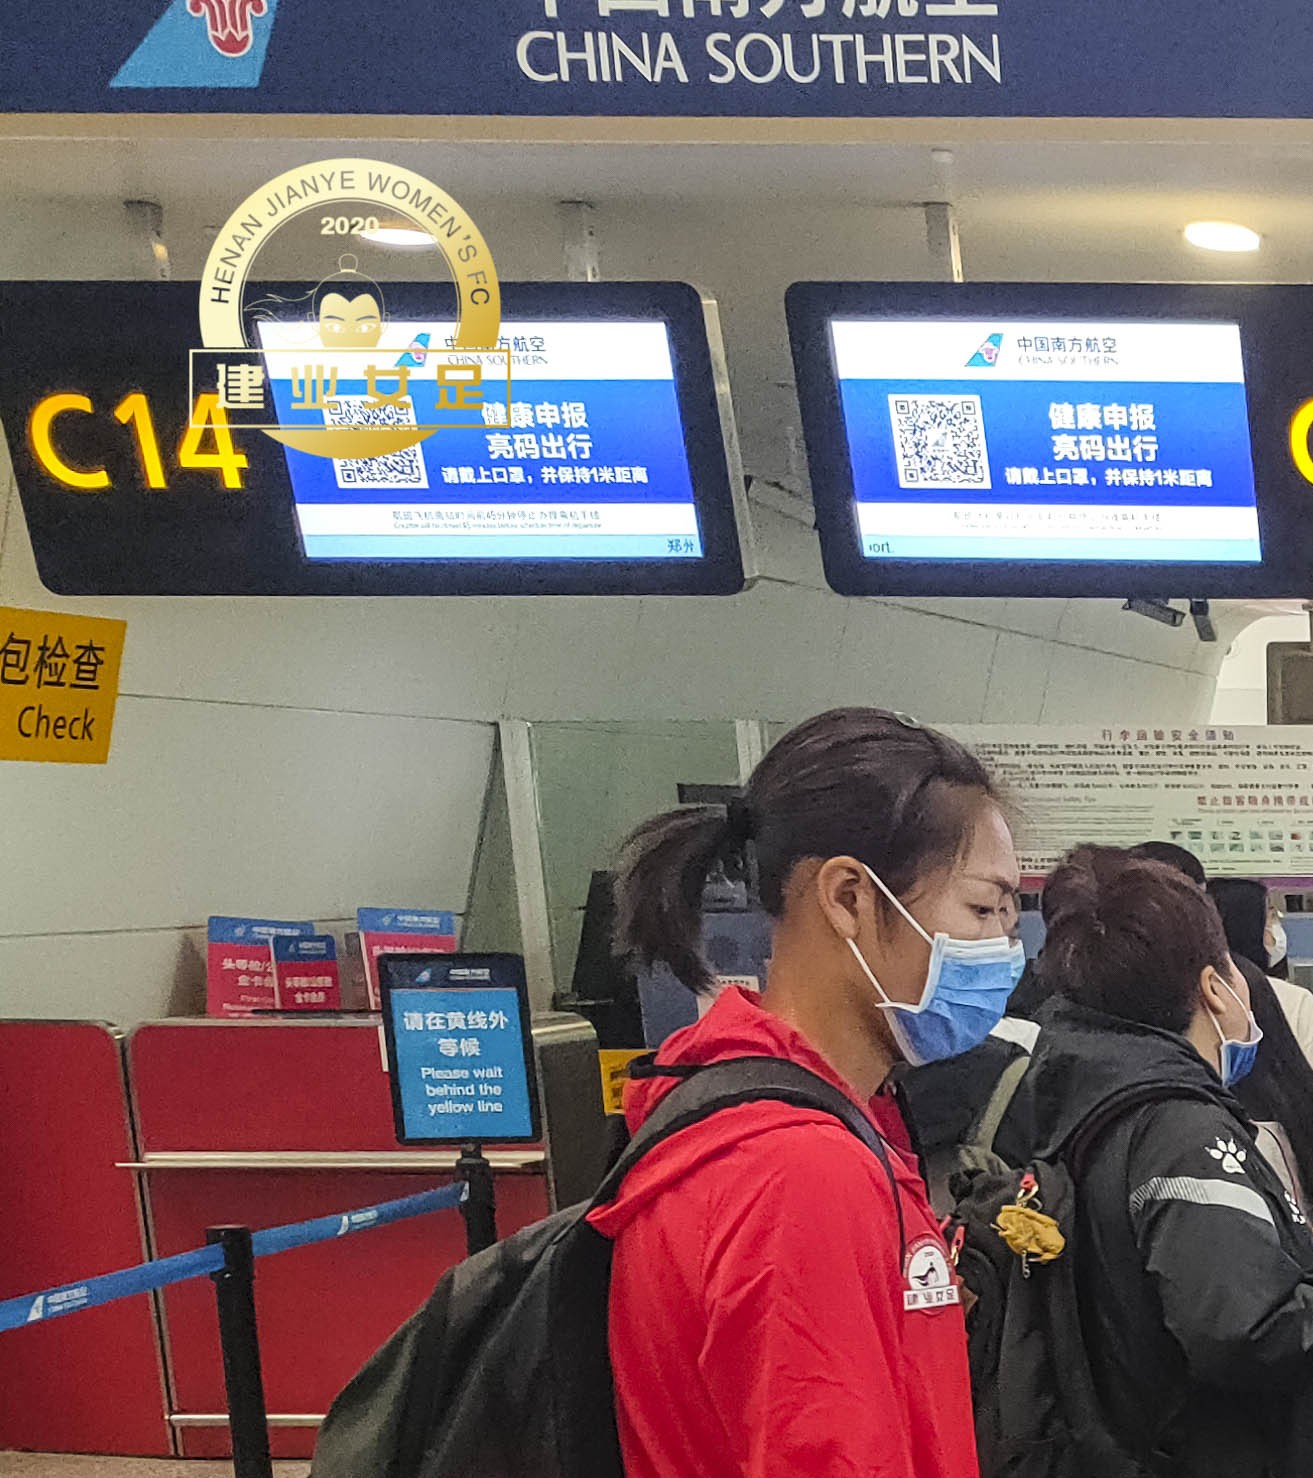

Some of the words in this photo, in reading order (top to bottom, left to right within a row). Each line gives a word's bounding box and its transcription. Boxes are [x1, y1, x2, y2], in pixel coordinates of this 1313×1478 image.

[516, 31, 689, 83] CHINA
[706, 32, 1001, 85] SOUTHERN
[1016, 336, 1118, 354] 中国南方航空
[481, 401, 589, 429] 健康申报
[1047, 402, 1157, 432] 健康申报
[29, 393, 249, 492] C14
[485, 433, 594, 460] 亮码出行
[1052, 434, 1160, 463] 亮码出行
[17, 704, 95, 741] Check
[403, 1011, 509, 1032] 请在黄线外
[437, 1038, 481, 1057] 等候
[421, 1066, 471, 1080] Please
[473, 1067, 504, 1079] wait
[425, 1083, 476, 1097] behind
[479, 1084, 503, 1096] the
[428, 1101, 475, 1115] yellow
[477, 1101, 504, 1113] line
